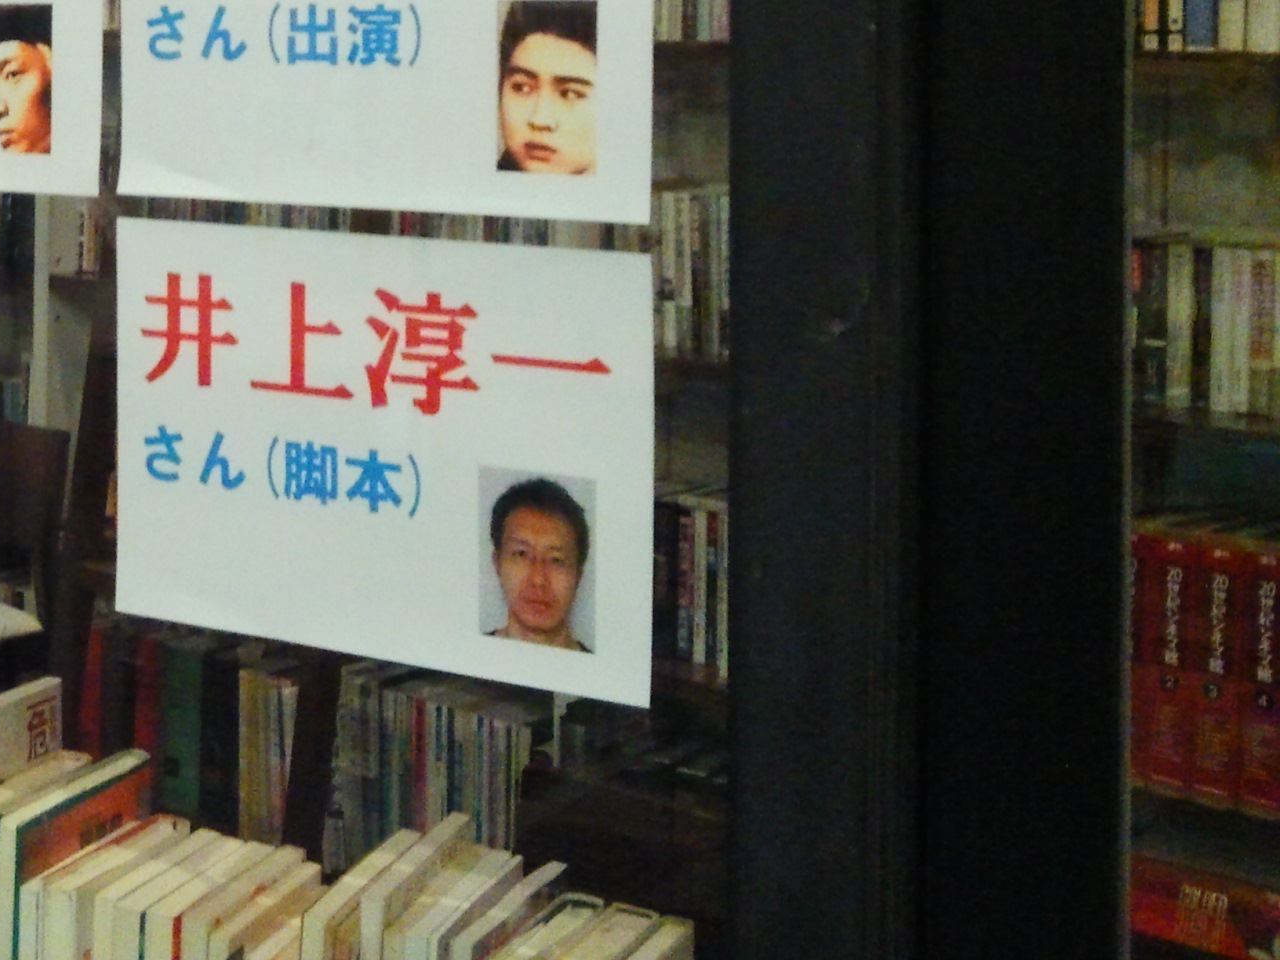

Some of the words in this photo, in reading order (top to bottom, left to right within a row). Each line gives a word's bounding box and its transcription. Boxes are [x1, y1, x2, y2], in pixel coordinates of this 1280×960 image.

[147, 2, 421, 67] さん(出演)
[141, 272, 612, 416] 井上淳一
[144, 425, 420, 518] さん(脚本)
